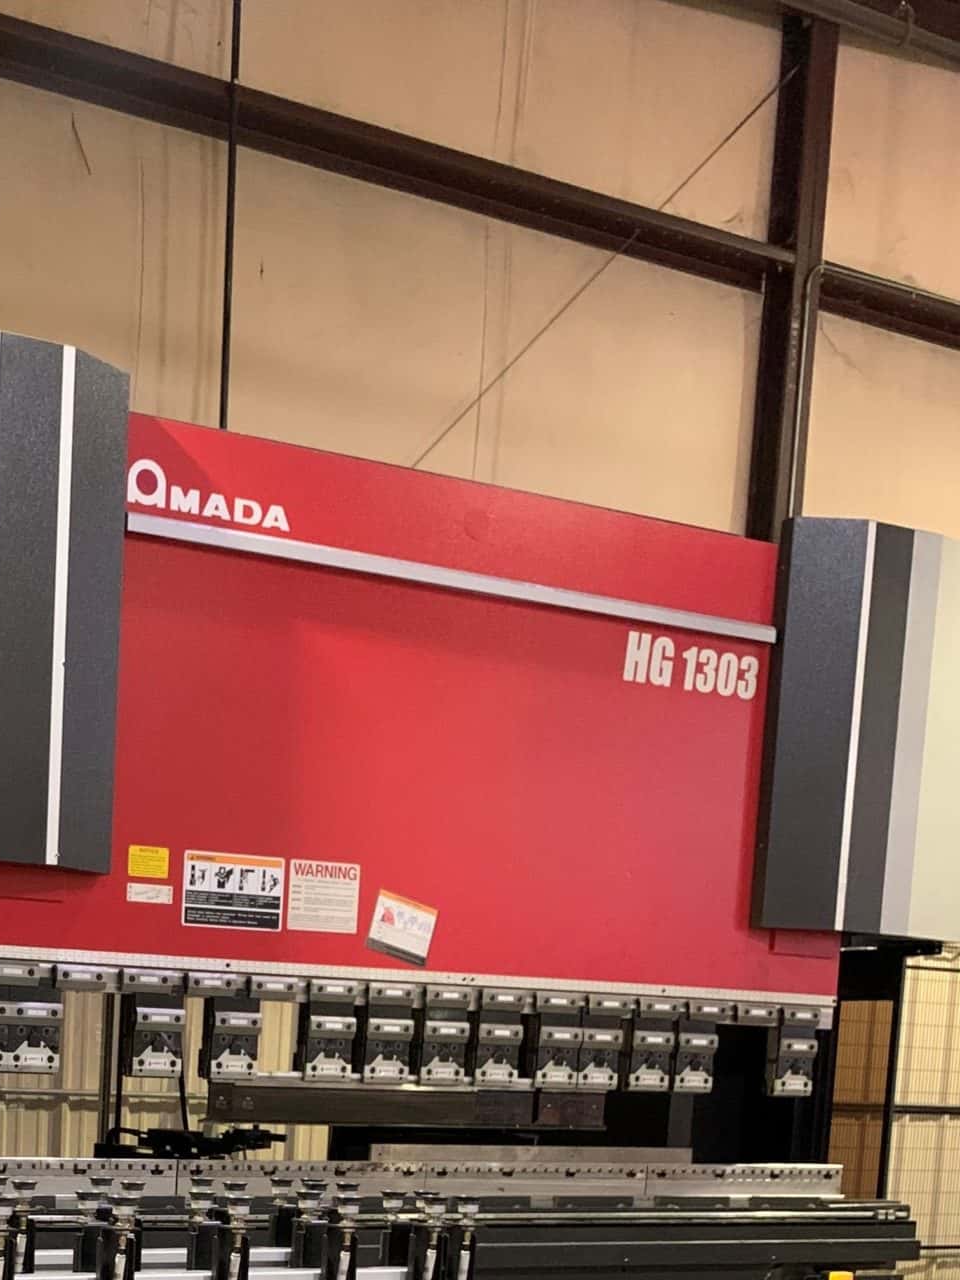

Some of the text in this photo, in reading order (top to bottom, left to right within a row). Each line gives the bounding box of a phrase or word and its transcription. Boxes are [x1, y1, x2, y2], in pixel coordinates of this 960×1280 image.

[127, 458, 290, 532] AMADA
[623, 630, 759, 700] HG 1303
[293, 862, 358, 881] WARNING
